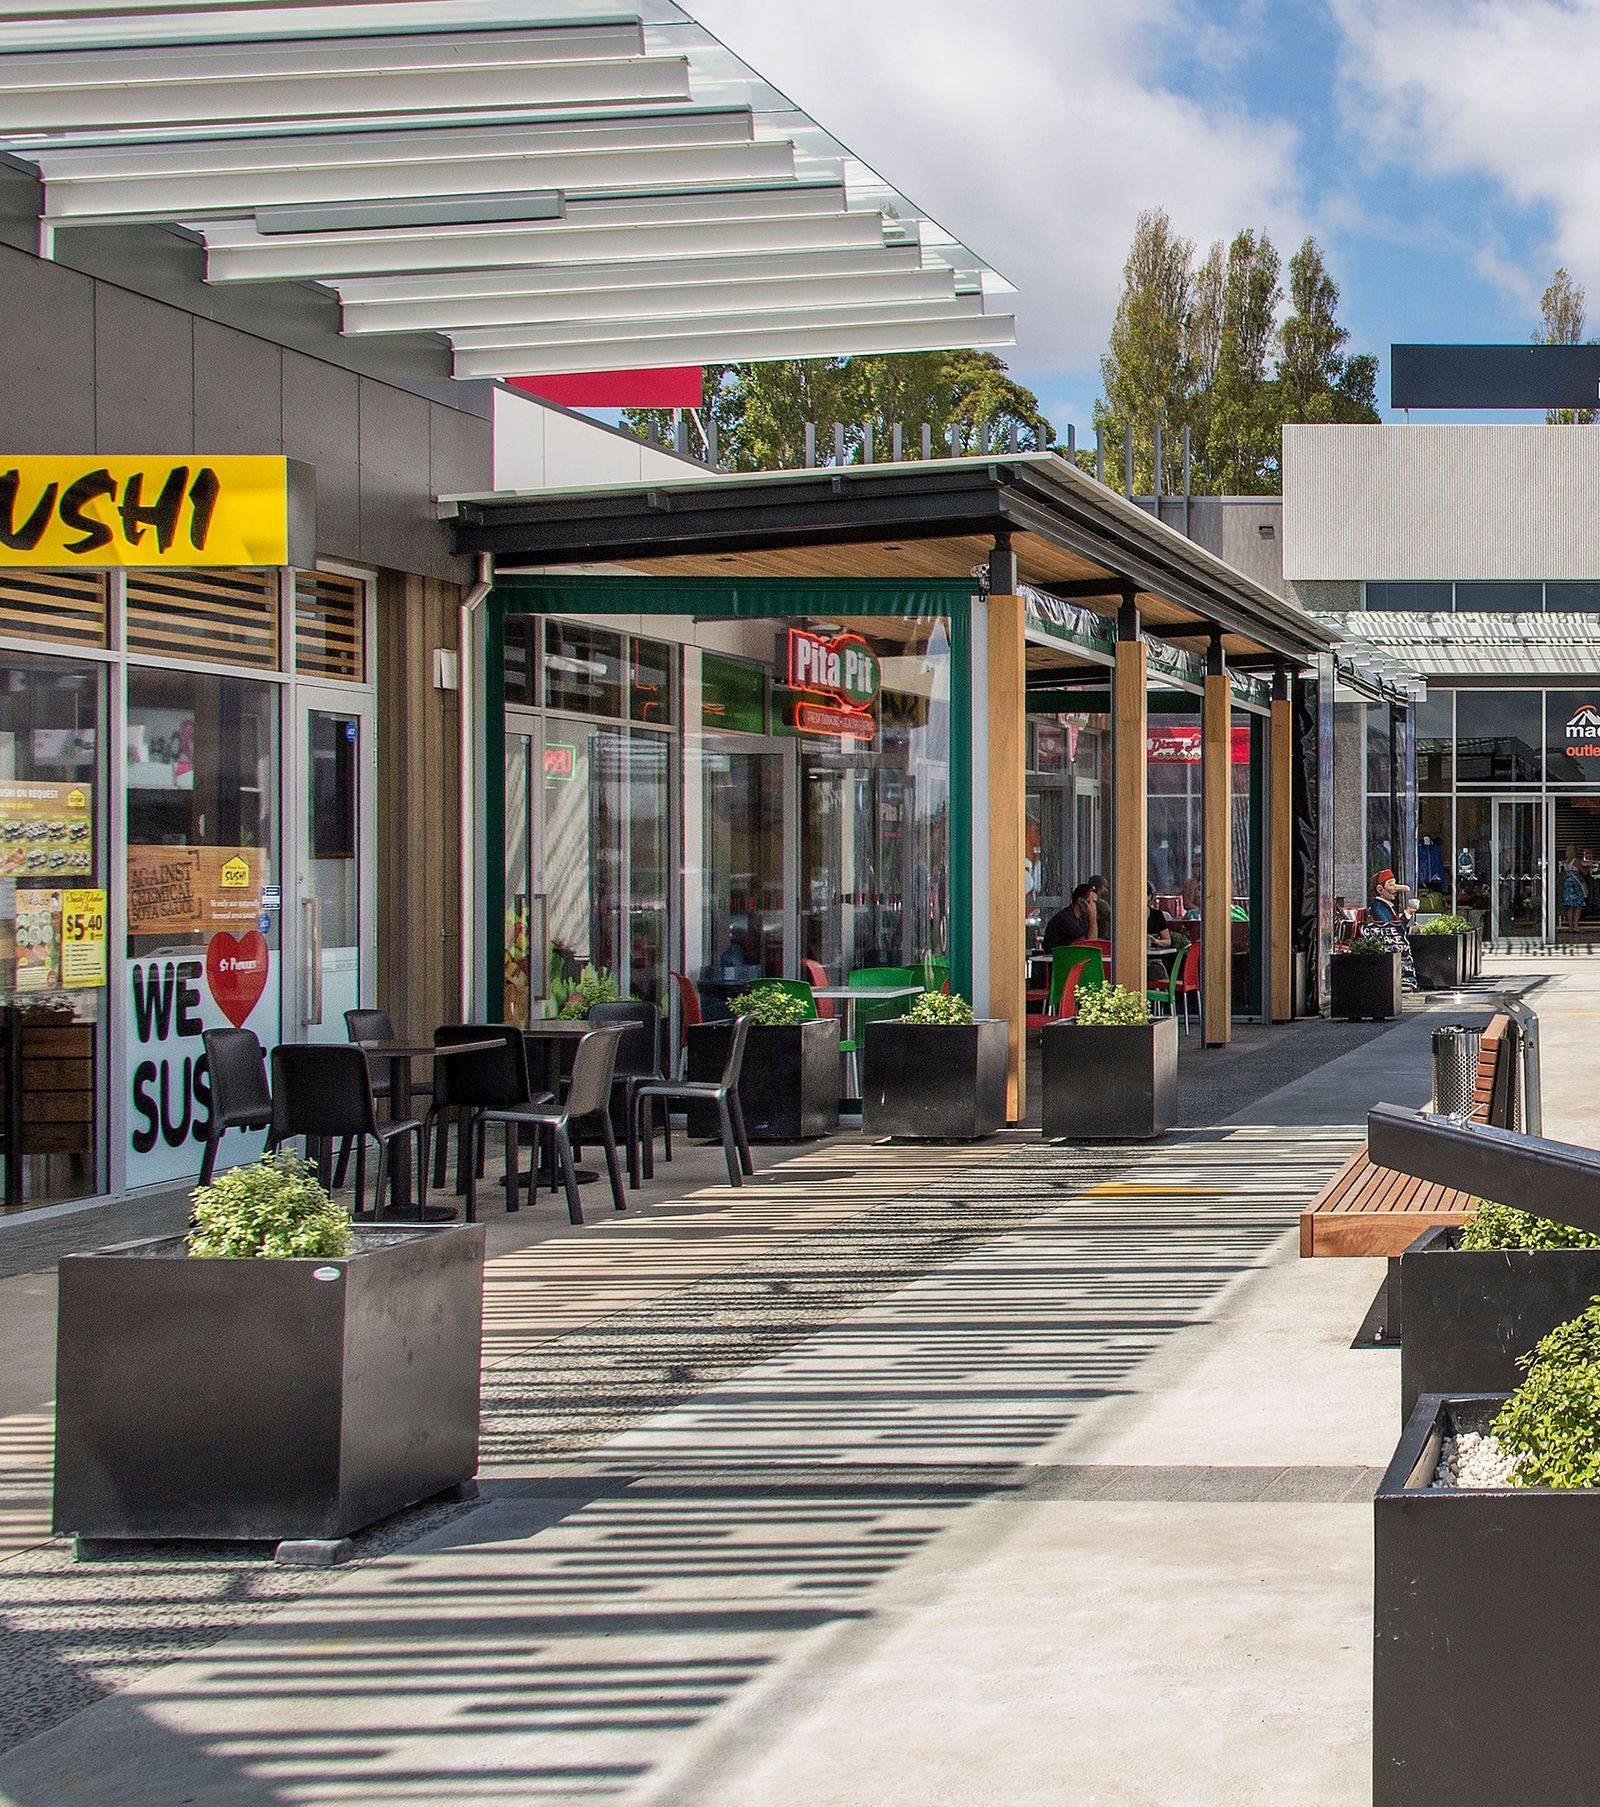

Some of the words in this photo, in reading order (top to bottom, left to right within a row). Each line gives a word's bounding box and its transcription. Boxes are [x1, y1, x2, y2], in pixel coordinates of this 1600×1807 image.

[797, 638, 840, 687] Pita
[845, 649, 873, 694] Pit
[132, 862, 193, 888] AGAINST
[131, 882, 193, 908] CHEMICAL
[67, 914, 102, 941] $5.40
[1364, 927, 1398, 936] COFFEE
[133, 961, 203, 1043] WE
